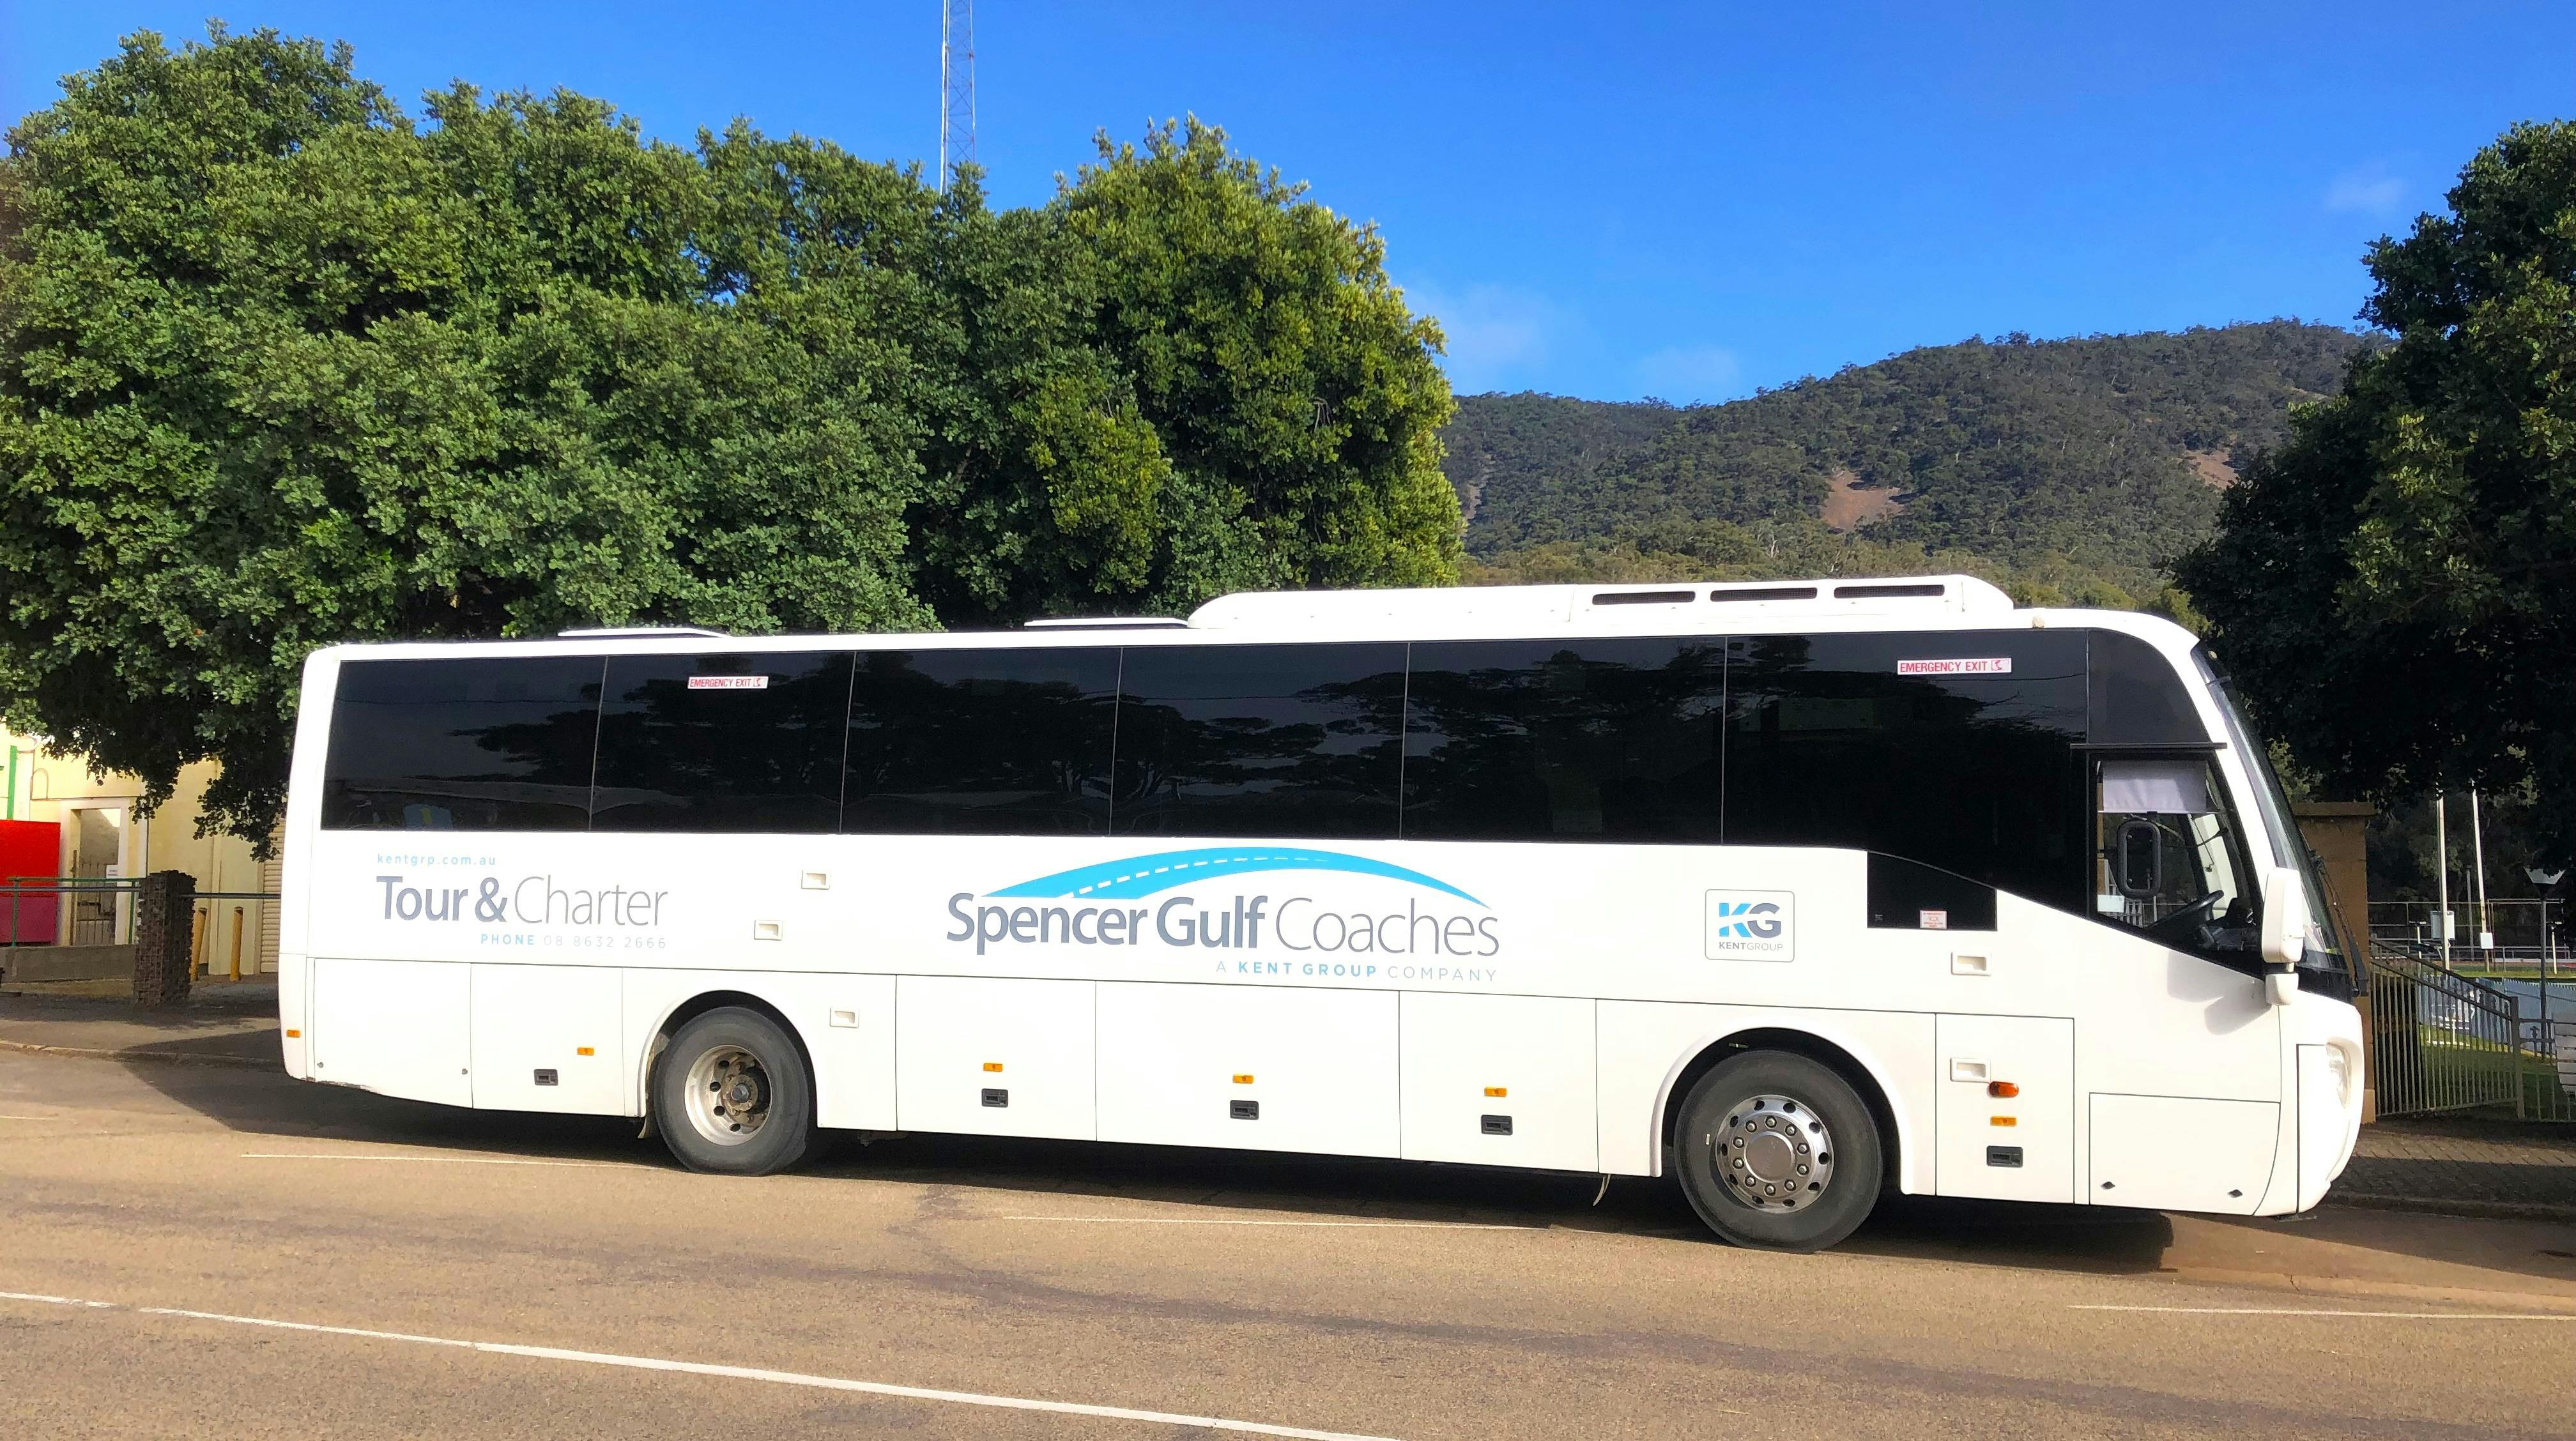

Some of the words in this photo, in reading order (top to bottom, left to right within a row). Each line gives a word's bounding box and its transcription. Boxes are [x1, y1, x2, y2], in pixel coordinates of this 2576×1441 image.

[1900, 662, 1961, 673] EMERGENCY
[1965, 661, 1988, 671] EXIT
[689, 679, 733, 687] EMERGENCY
[735, 678, 751, 687] EXIT
[377, 853, 497, 866] kentgrp.com.au
[376, 876, 468, 921] Tour
[475, 877, 508, 923] &
[514, 874, 668, 926] Charter
[946, 892, 1148, 956] Spencer
[1156, 895, 1268, 949] Gulf
[1275, 897, 1499, 957] Coaches
[1719, 902, 1782, 939] KG
[480, 934, 535, 945] PHONE
[544, 935, 564, 946] 08
[572, 936, 615, 948] 8632
[624, 936, 667, 949] 2666
[1216, 961, 1227, 972] A
[1238, 961, 1292, 975] KENT
[1303, 963, 1377, 978] GROUP
[1388, 966, 1498, 982] COMPANY
